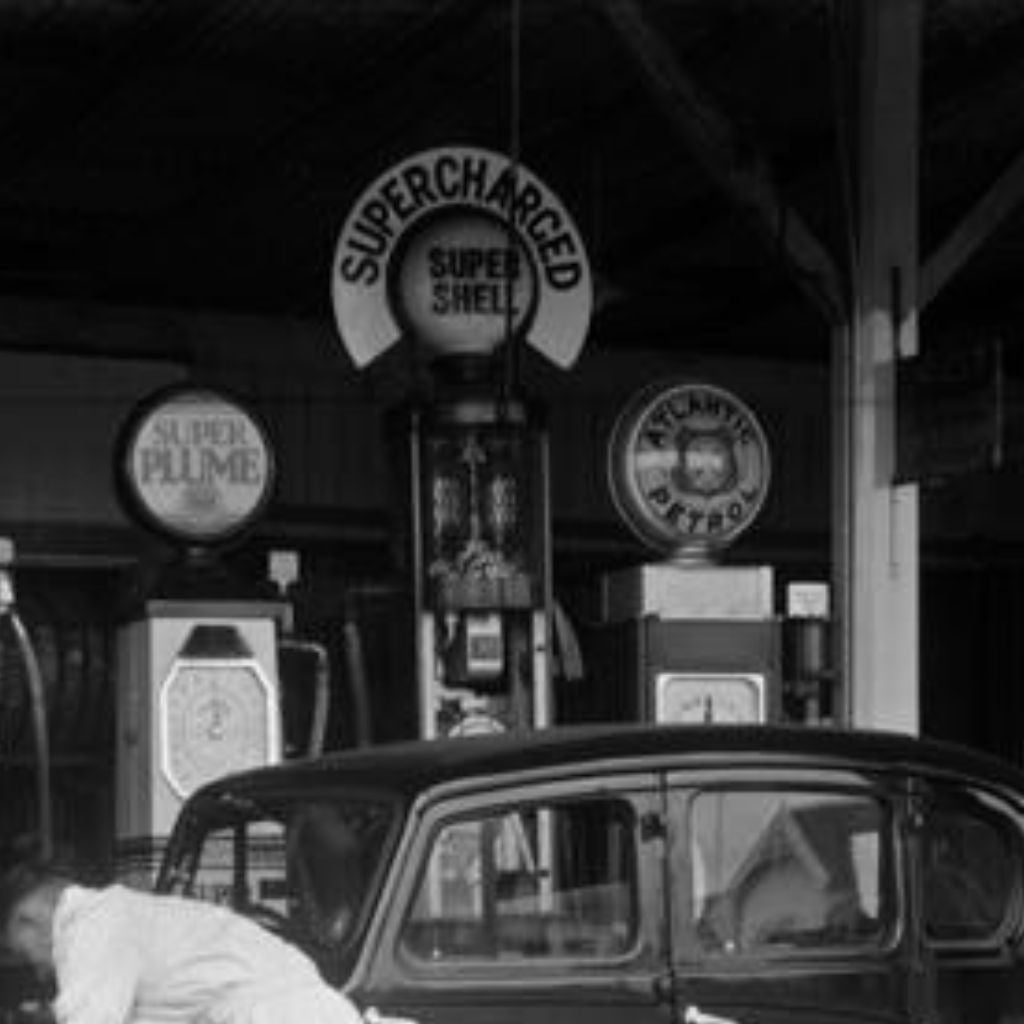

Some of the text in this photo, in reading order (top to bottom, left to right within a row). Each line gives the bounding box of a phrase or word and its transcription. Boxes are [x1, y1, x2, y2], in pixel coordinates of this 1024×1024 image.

[340, 154, 582, 291] SUPERCHARGED
[428, 248, 520, 279] SUPER
[431, 284, 520, 316] SHELL
[151, 420, 247, 444] SUPER
[640, 391, 751, 446] ATLANTIC
[141, 448, 261, 485] PLUME
[649, 487, 759, 533] PETROL
